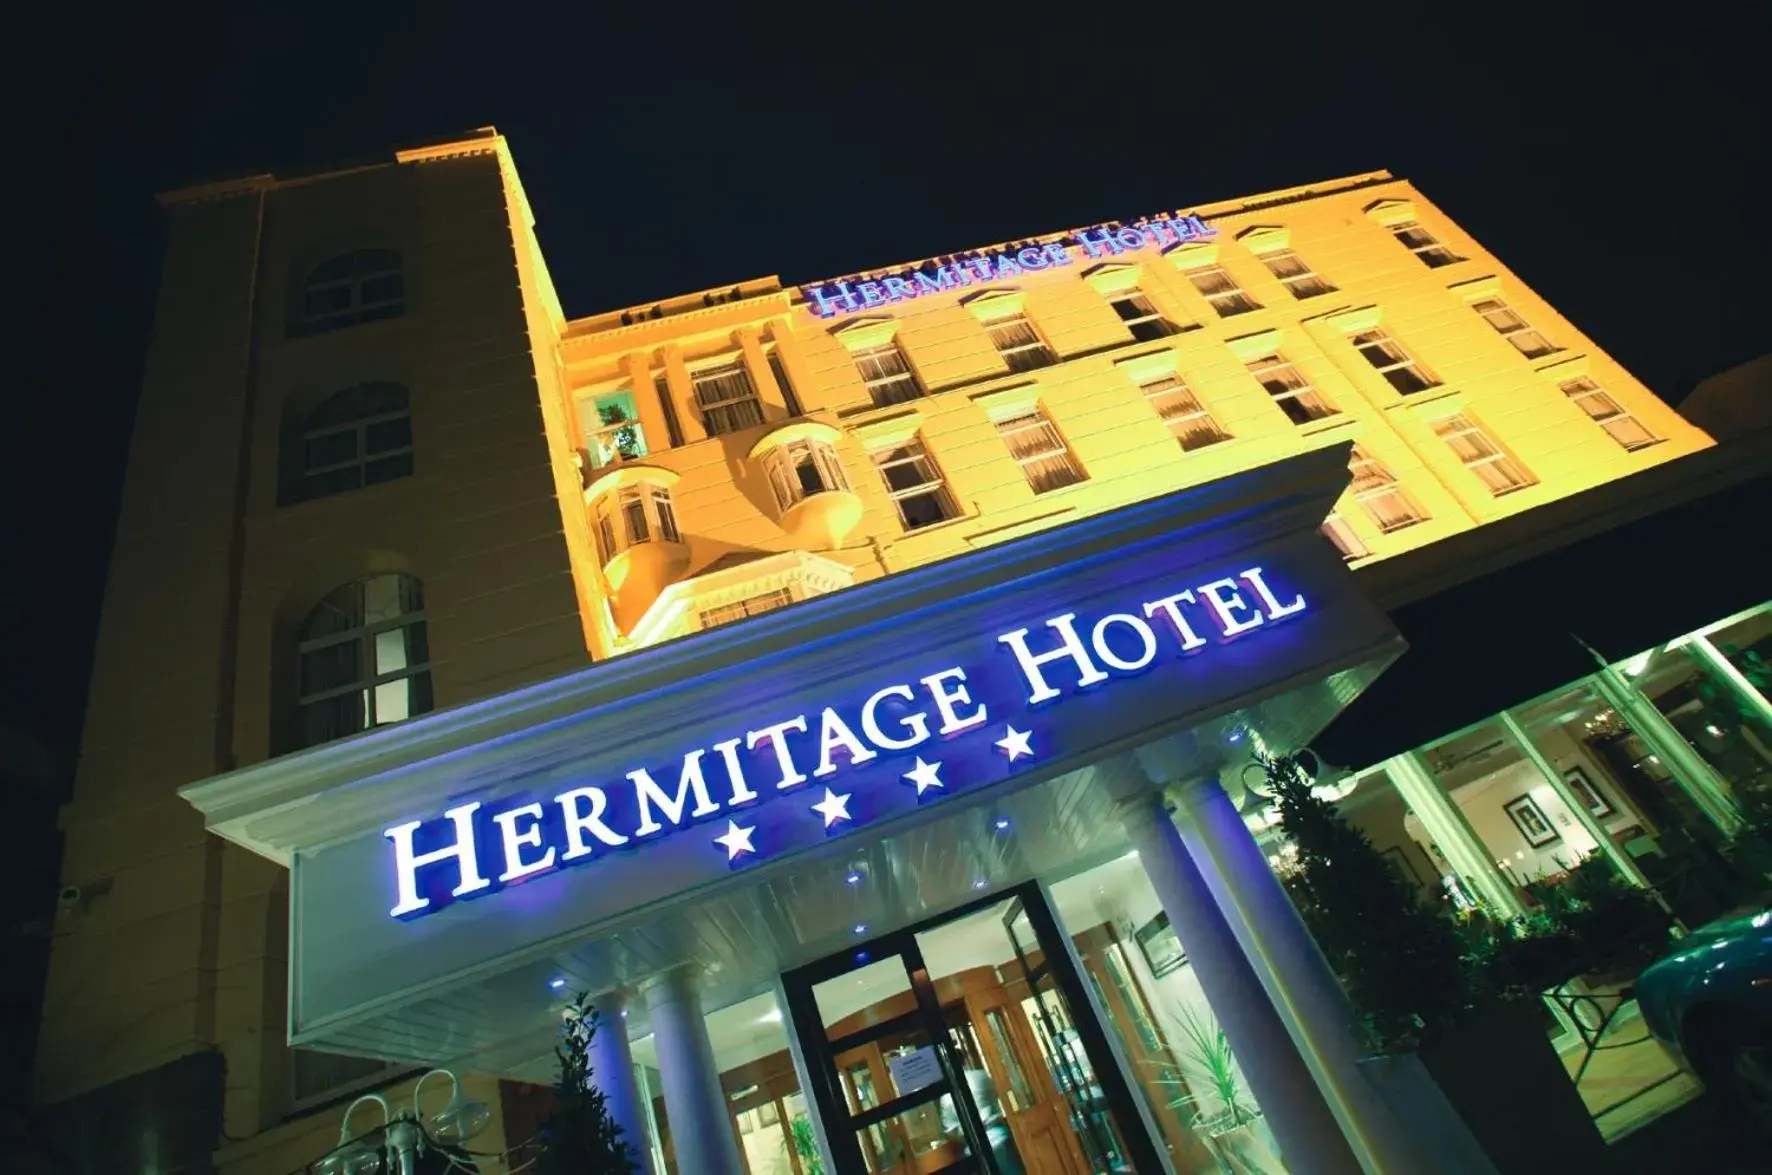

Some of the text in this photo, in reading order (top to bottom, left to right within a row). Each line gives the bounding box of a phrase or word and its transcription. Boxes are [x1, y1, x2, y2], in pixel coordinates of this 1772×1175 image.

[809, 214, 1217, 317] HERMITAGE HOTEL
[383, 566, 1307, 917] HERMITAGE HOTEL
